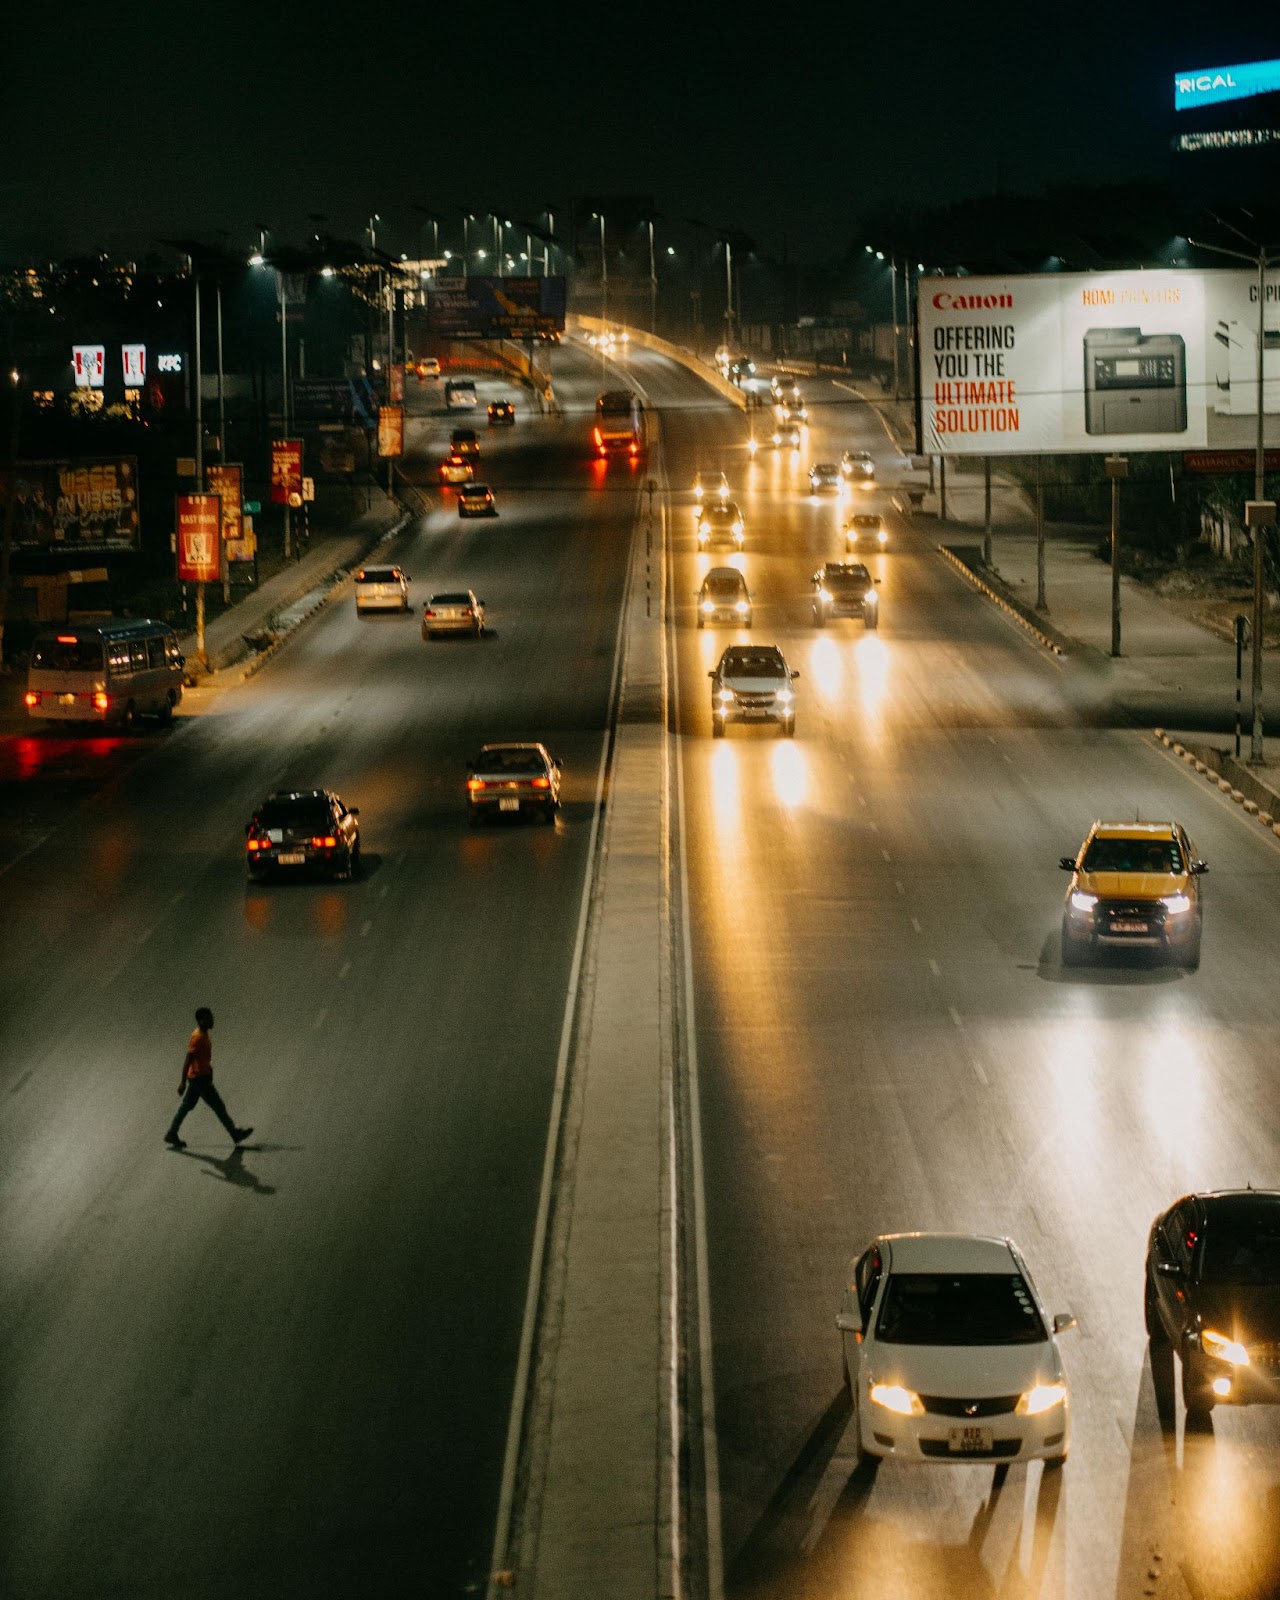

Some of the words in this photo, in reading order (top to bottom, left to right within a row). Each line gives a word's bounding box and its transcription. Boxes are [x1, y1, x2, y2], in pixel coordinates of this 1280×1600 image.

[932, 292, 1013, 310] Canon
[934, 325, 1015, 351] OFFERING
[157, 354, 181, 372] KFC
[934, 353, 968, 378] YOU
[973, 353, 1005, 377] THE
[935, 380, 1016, 405] ULTIMATE
[936, 408, 1019, 434] SOLUTION
